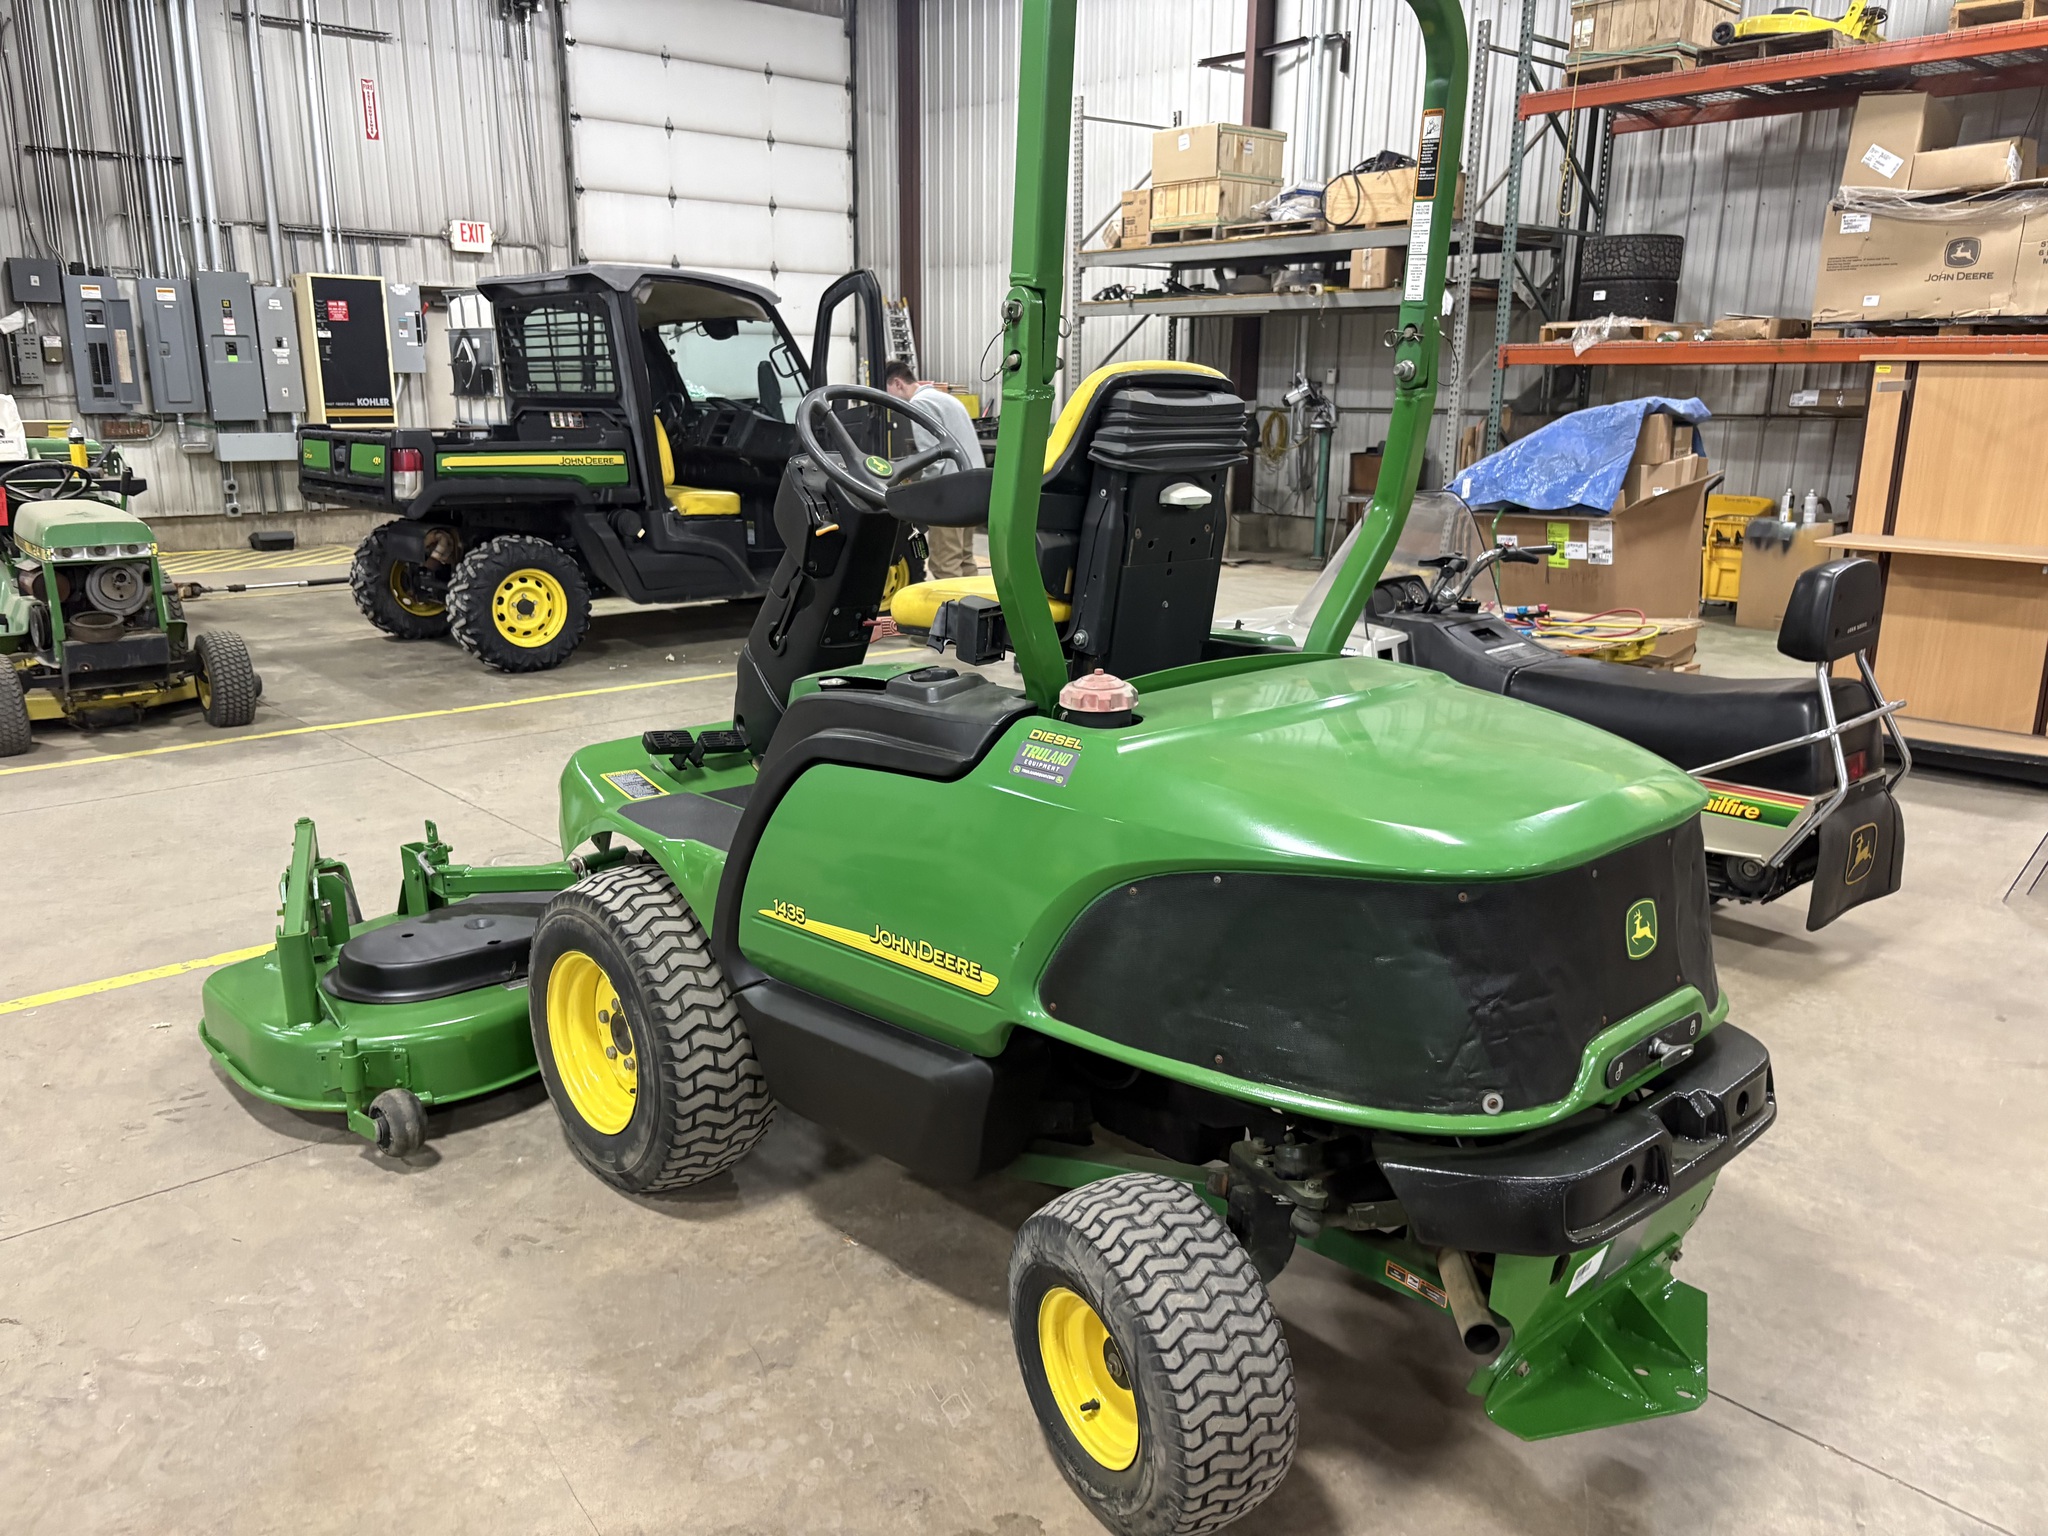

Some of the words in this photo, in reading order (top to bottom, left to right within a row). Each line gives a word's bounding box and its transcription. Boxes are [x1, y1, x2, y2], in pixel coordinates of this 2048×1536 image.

[460, 222, 485, 244] EXIT
[1924, 272, 1954, 283] JOHN
[1956, 271, 1995, 281] DEERE
[356, 397, 390, 407] KOHLER
[559, 456, 584, 466] JOHN
[585, 456, 615, 466] DEERE
[1028, 728, 1084, 751] DIESEL
[1021, 743, 1074, 767] TRULAND
[1023, 758, 1061, 772] EQUIPMENT
[773, 898, 806, 925] 1435
[869, 923, 920, 958] JOHN
[918, 939, 983, 983] DEERE
